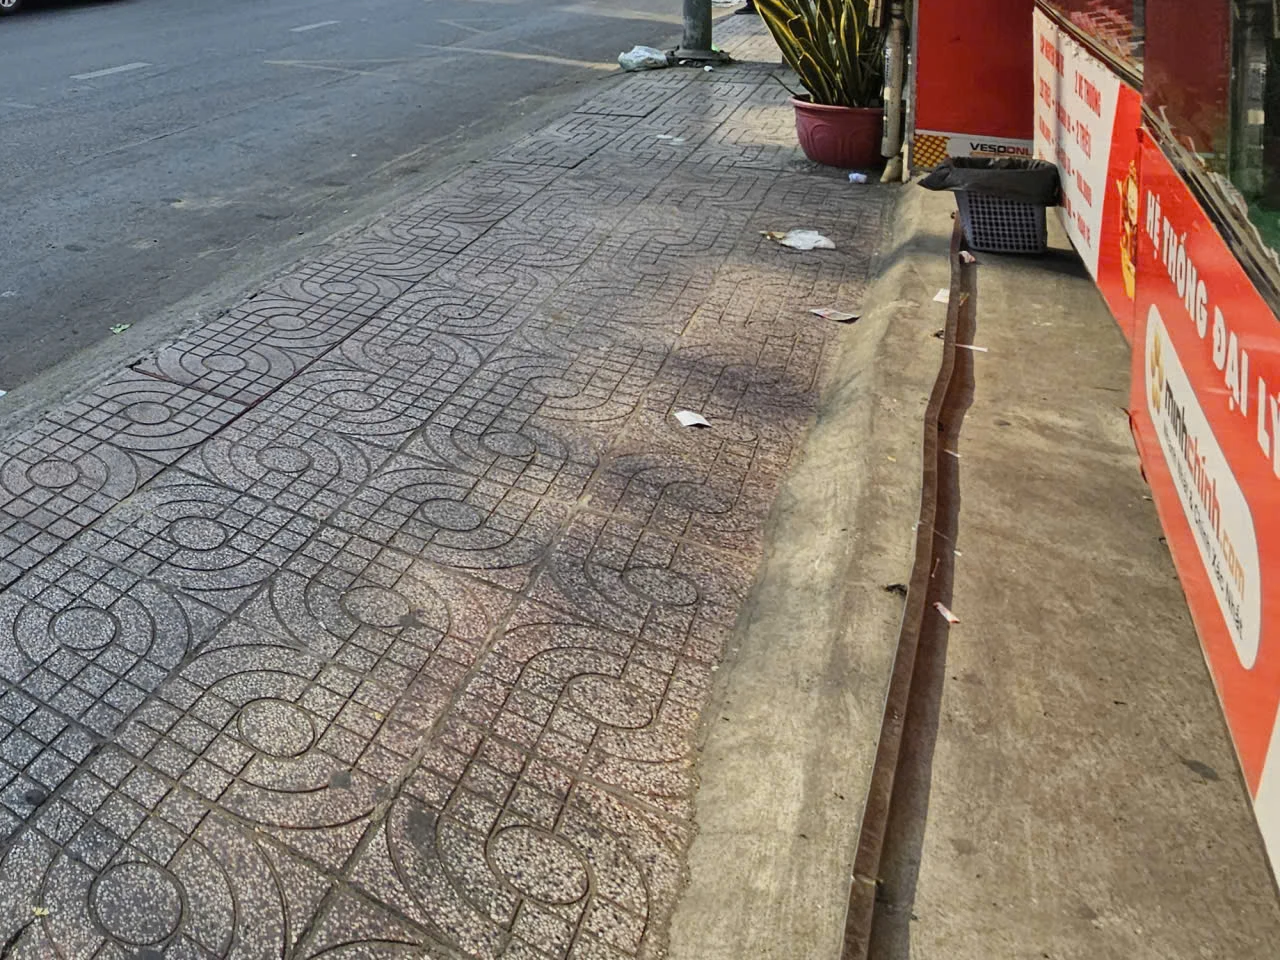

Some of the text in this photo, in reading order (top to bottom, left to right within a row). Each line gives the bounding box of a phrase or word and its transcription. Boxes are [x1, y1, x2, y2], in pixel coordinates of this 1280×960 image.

[1146, 190, 1161, 259] HỆ
[1163, 216, 1208, 339] THỐNG
[1213, 305, 1248, 418] ĐẠI
